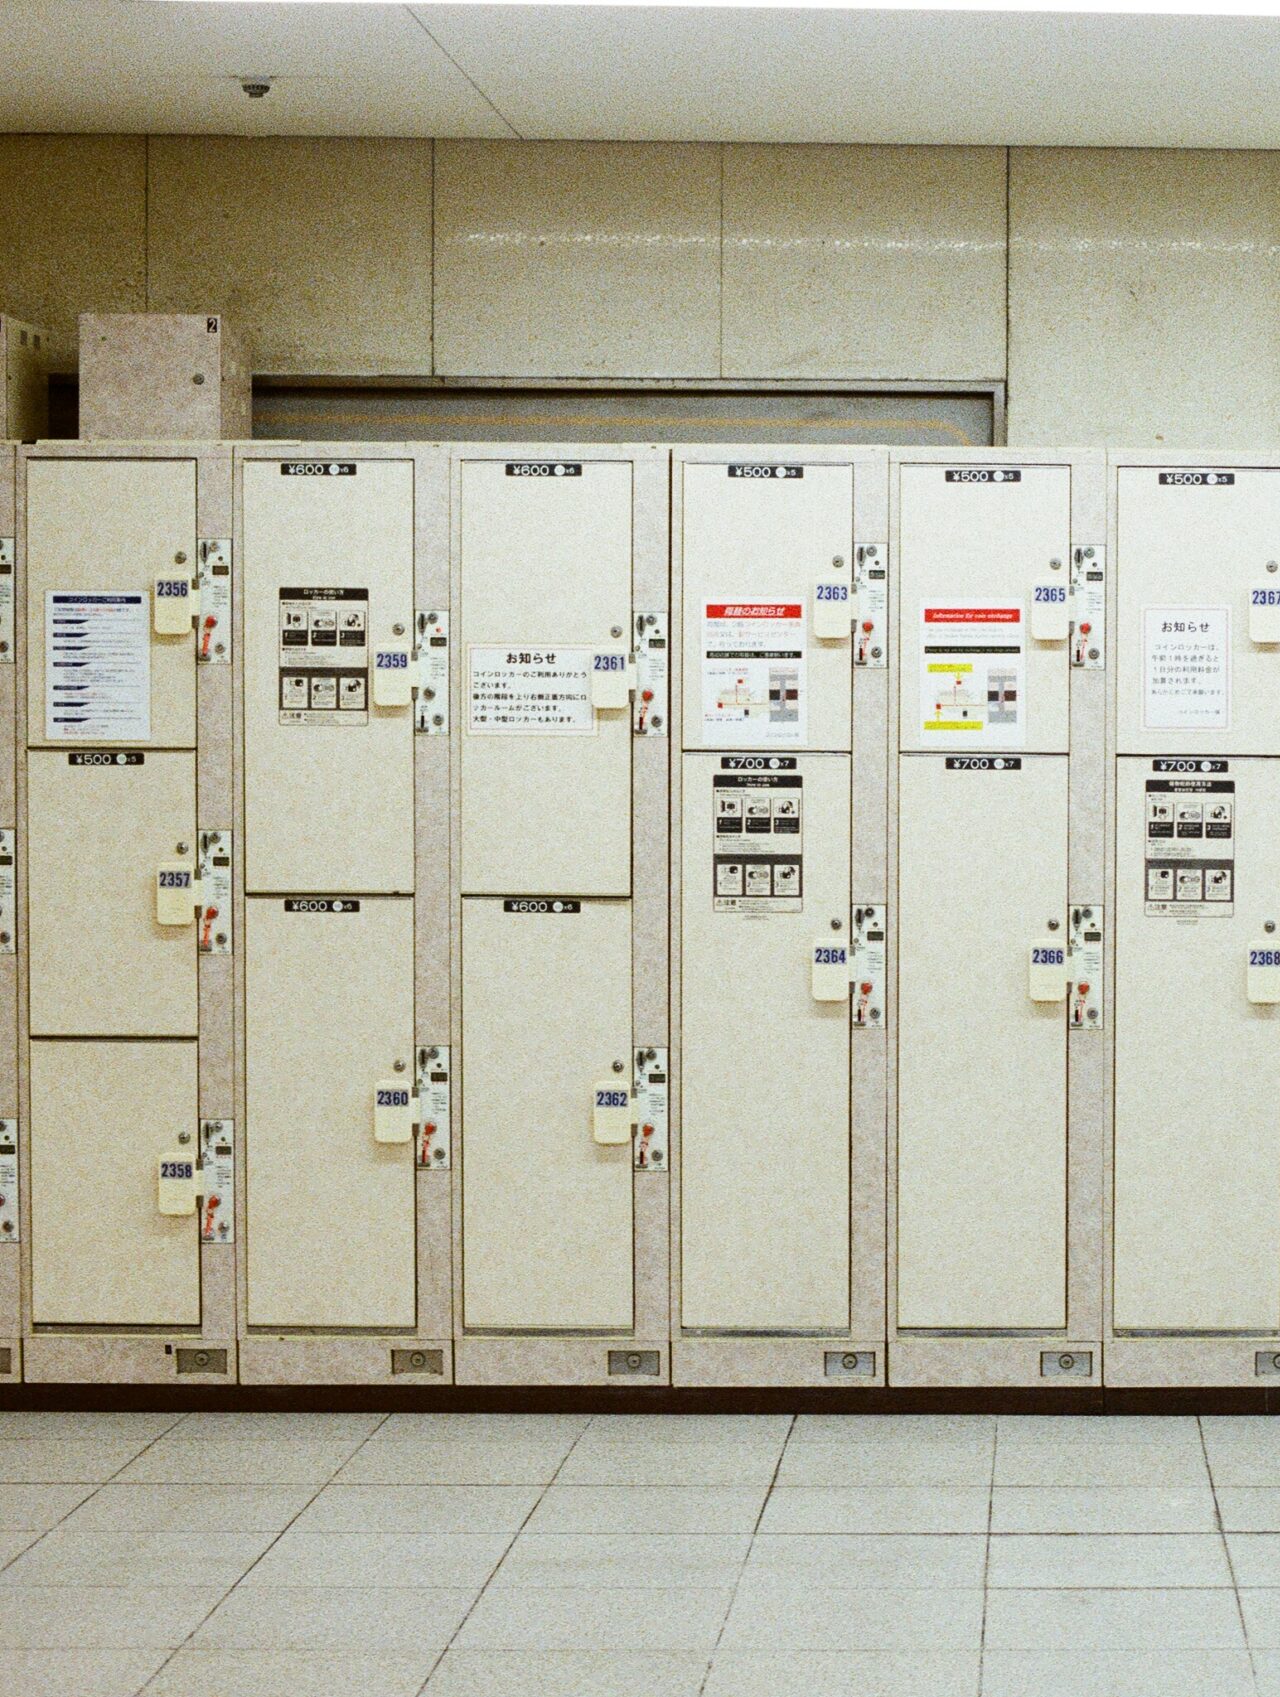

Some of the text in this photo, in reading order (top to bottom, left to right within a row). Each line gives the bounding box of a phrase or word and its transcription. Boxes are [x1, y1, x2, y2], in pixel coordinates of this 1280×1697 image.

[209, 318, 216, 333] 2
[289, 464, 324, 475] ¥600
[513, 465, 549, 476] ¥600
[735, 466, 771, 477] ¥500
[953, 471, 989, 481] ¥500
[1166, 473, 1202, 484] ¥500
[157, 582, 188, 597] 2356
[816, 585, 847, 600] 2363
[1035, 587, 1066, 602] 2365
[1162, 621, 1210, 633] お知らせ
[377, 654, 407, 668] 2359
[506, 653, 557, 664] お知らせ
[594, 656, 624, 670] 2361
[76, 754, 112, 765] ¥500
[729, 758, 764, 768] ¥700
[953, 759, 989, 769] ¥700
[1160, 761, 1196, 771] ¥700
[160, 872, 190, 887] 2357
[292, 901, 327, 911] ¥600
[512, 901, 547, 912] ¥600
[816, 948, 846, 964] 2364
[1032, 950, 1063, 964] 2366
[1250, 951, 1280, 966] 2368
[377, 1090, 408, 1106] 2360
[597, 1091, 627, 1106] 2362
[160, 1163, 192, 1178] 2358
